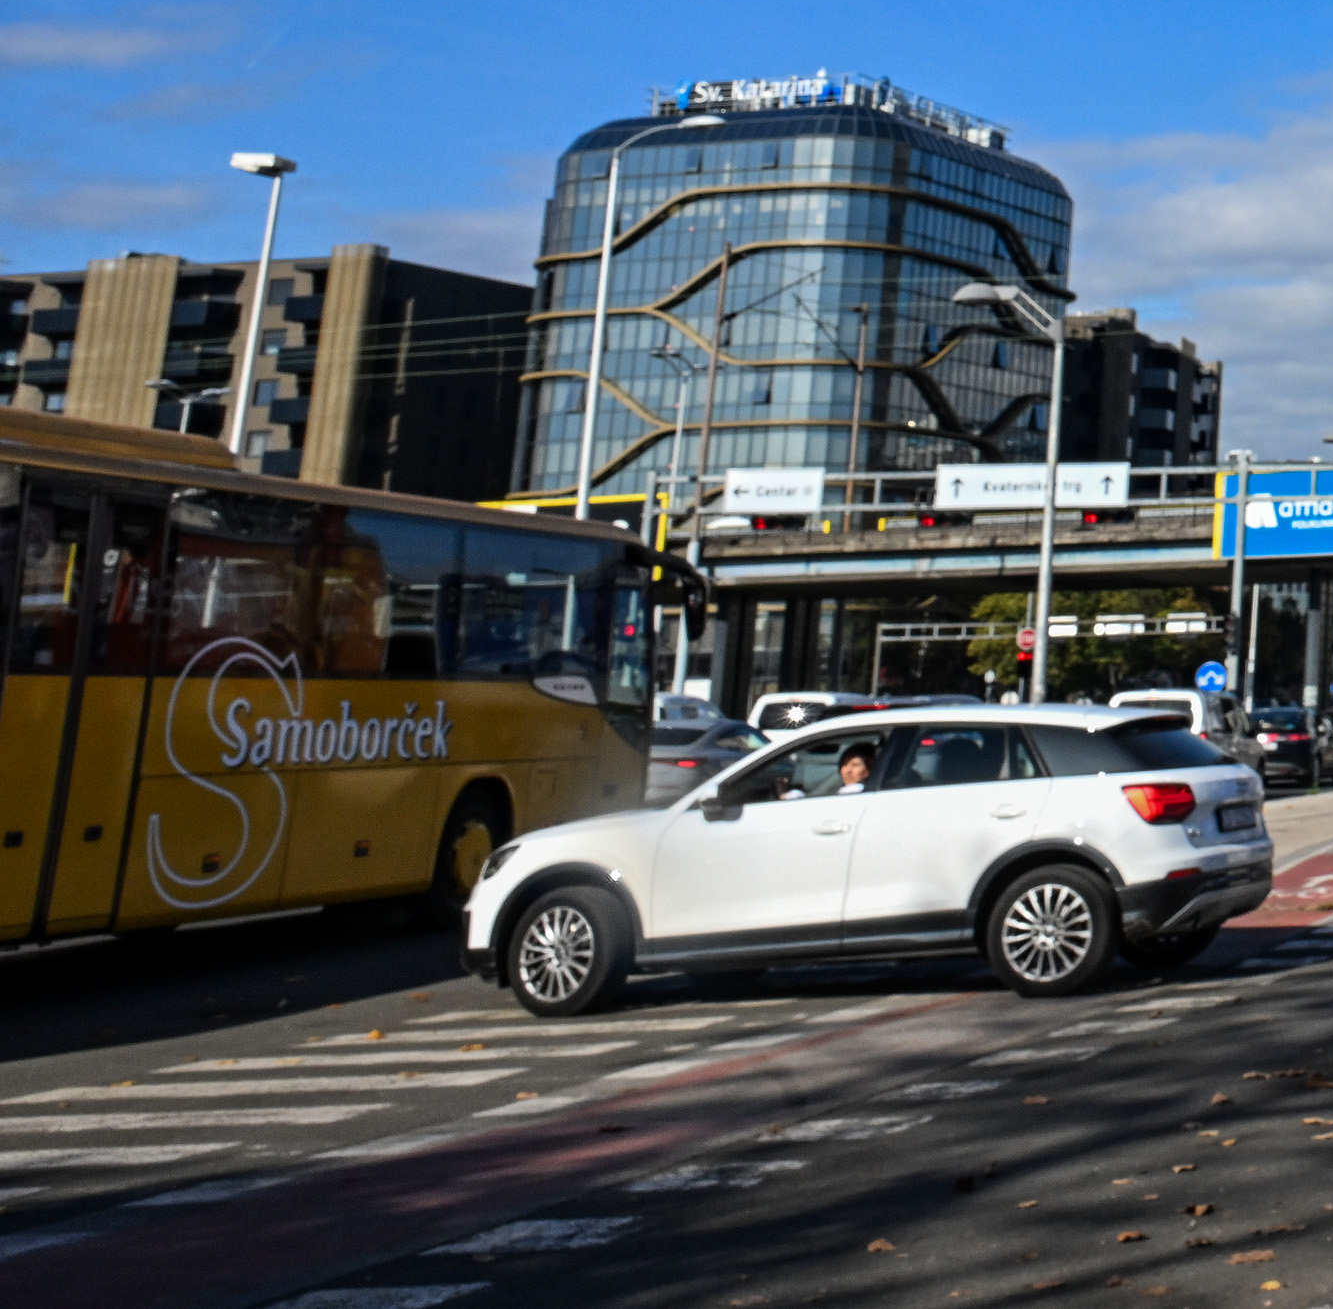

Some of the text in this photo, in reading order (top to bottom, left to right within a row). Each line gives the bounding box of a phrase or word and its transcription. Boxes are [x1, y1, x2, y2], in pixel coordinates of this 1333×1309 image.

[694, 76, 827, 103] Sv. Katarina
[221, 697, 452, 768] Samoborček
